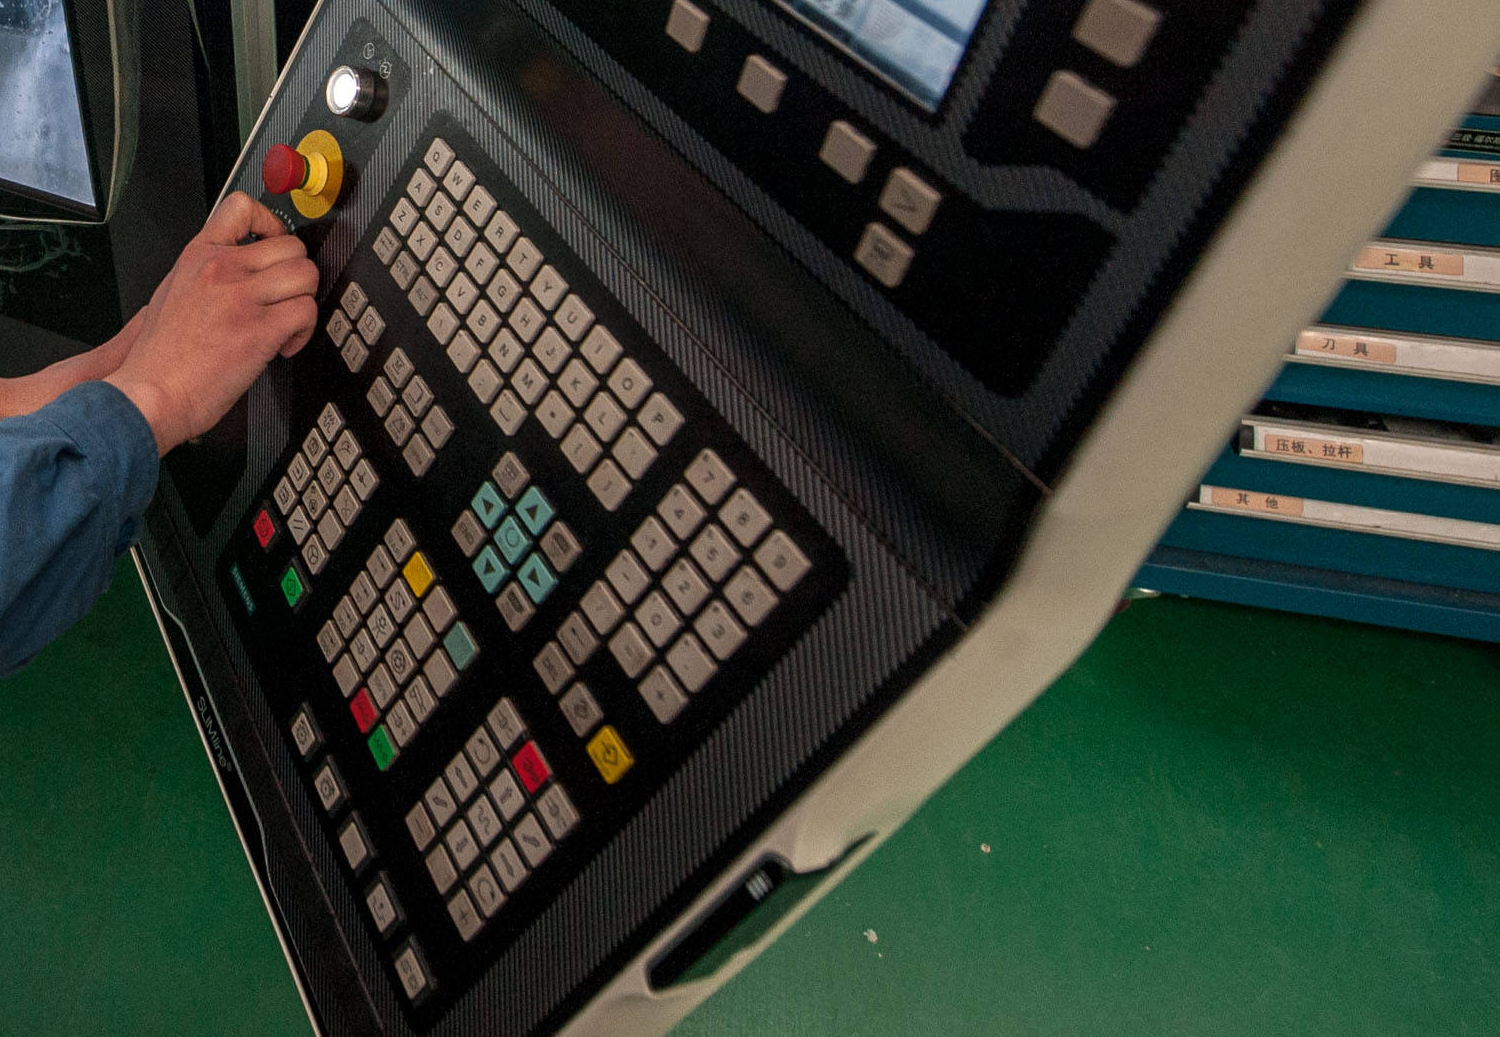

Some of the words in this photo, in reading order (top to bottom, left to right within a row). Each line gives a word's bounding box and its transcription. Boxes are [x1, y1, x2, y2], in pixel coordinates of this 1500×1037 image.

[1384, 252, 1434, 270] 工具
[432, 151, 441, 163] Q
[452, 172, 463, 186] W
[472, 199, 482, 211] E
[495, 226, 505, 238] R
[519, 252, 528, 263] T
[543, 282, 553, 293] Y
[567, 310, 578, 324] U
[621, 377, 633, 390] O
[652, 412, 663, 424] P
[398, 211, 406, 222] Z
[416, 234, 426, 246] X
[435, 261, 444, 272] C
[456, 287, 466, 298] V
[477, 315, 487, 327] B
[500, 344, 510, 358] N
[521, 373, 534, 389] M
[414, 182, 422, 193] A
[434, 205, 443, 216] S
[453, 230, 462, 241] D
[475, 258, 485, 268] F
[498, 285, 508, 298] G
[520, 314, 530, 327] H
[570, 377, 581, 390] K
[597, 414, 606, 426] L
[1321, 337, 1370, 358] 刀具
[1276, 438, 1354, 460] 压板、拉杆
[703, 471, 715, 484] 7
[1235, 492, 1280, 510] 其他
[674, 508, 685, 520] 4
[678, 580, 691, 594] 2
